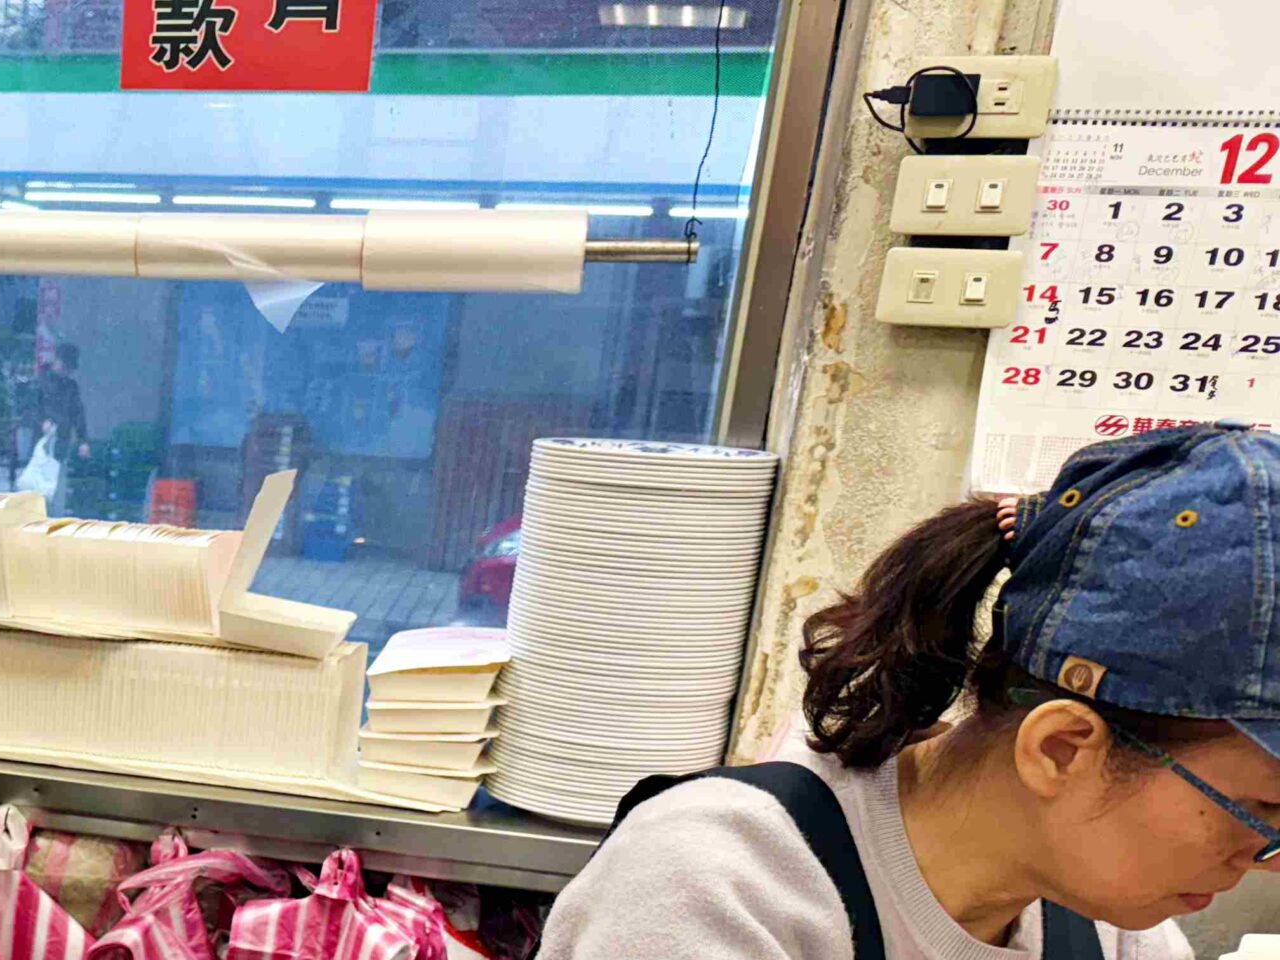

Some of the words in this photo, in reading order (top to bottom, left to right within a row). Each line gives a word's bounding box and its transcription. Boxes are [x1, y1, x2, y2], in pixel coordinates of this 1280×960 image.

[149, 0, 237, 71] 款
[1220, 132, 1280, 184] 12
[1138, 165, 1204, 177] December
[1047, 200, 1070, 211] 30
[1108, 201, 1122, 219] 1
[1161, 202, 1184, 221] 2
[1222, 203, 1244, 222] 3
[1040, 243, 1059, 260] 7
[1095, 244, 1115, 263] 8
[1153, 245, 1174, 264] 9
[1205, 247, 1245, 266] 10
[1023, 284, 1059, 303] 14
[1078, 286, 1117, 305] 15
[1136, 288, 1175, 308] 16
[1194, 290, 1235, 309] 17
[1010, 325, 1047, 345] 21
[1065, 328, 1107, 347] 22
[1122, 330, 1163, 349] 23
[1179, 332, 1222, 351] 24
[1238, 334, 1280, 354] 25
[1001, 367, 1041, 386] 28
[1056, 369, 1097, 388] 29
[1113, 371, 1154, 390] 30
[1169, 374, 1209, 393] 31
